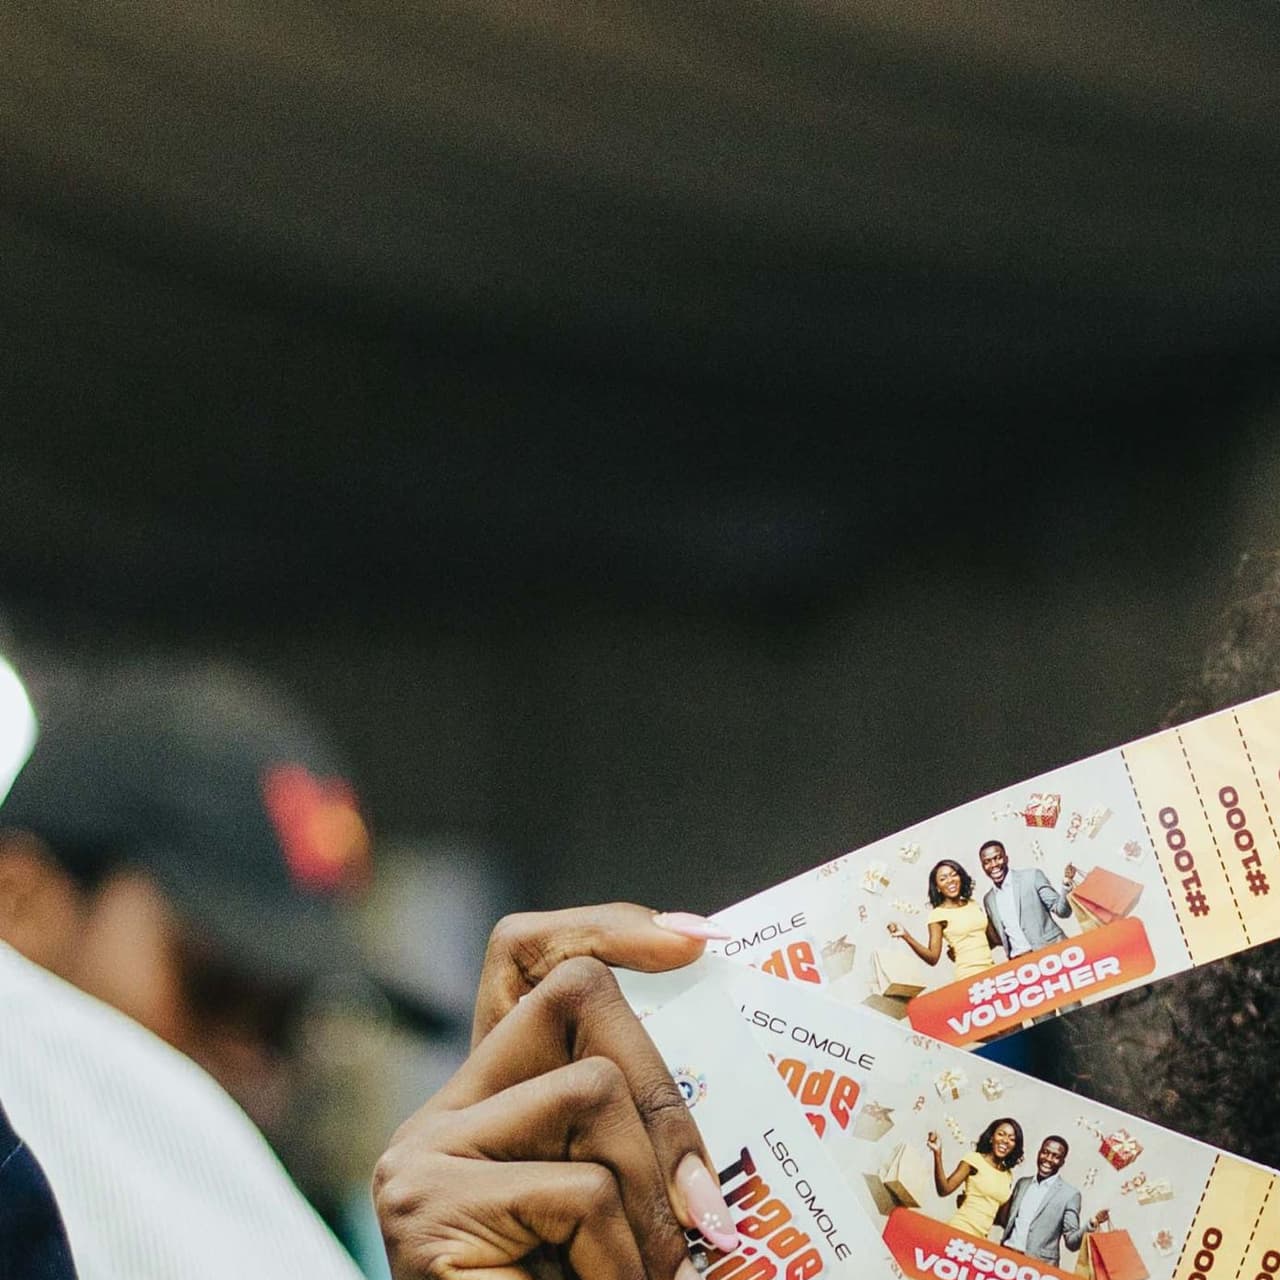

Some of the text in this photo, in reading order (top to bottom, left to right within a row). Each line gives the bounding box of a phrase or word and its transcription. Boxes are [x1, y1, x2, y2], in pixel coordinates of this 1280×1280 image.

[1159, 807, 1210, 917] #1000
[1219, 786, 1270, 897] #1000
[724, 911, 807, 957] OMOLE
[946, 956, 1121, 1036] VOUCHER
[967, 945, 1087, 1005] #5000
[791, 1026, 876, 1071] OMOLE
[762, 1127, 798, 1177] LSC
[794, 1179, 852, 1262] OMOLE
